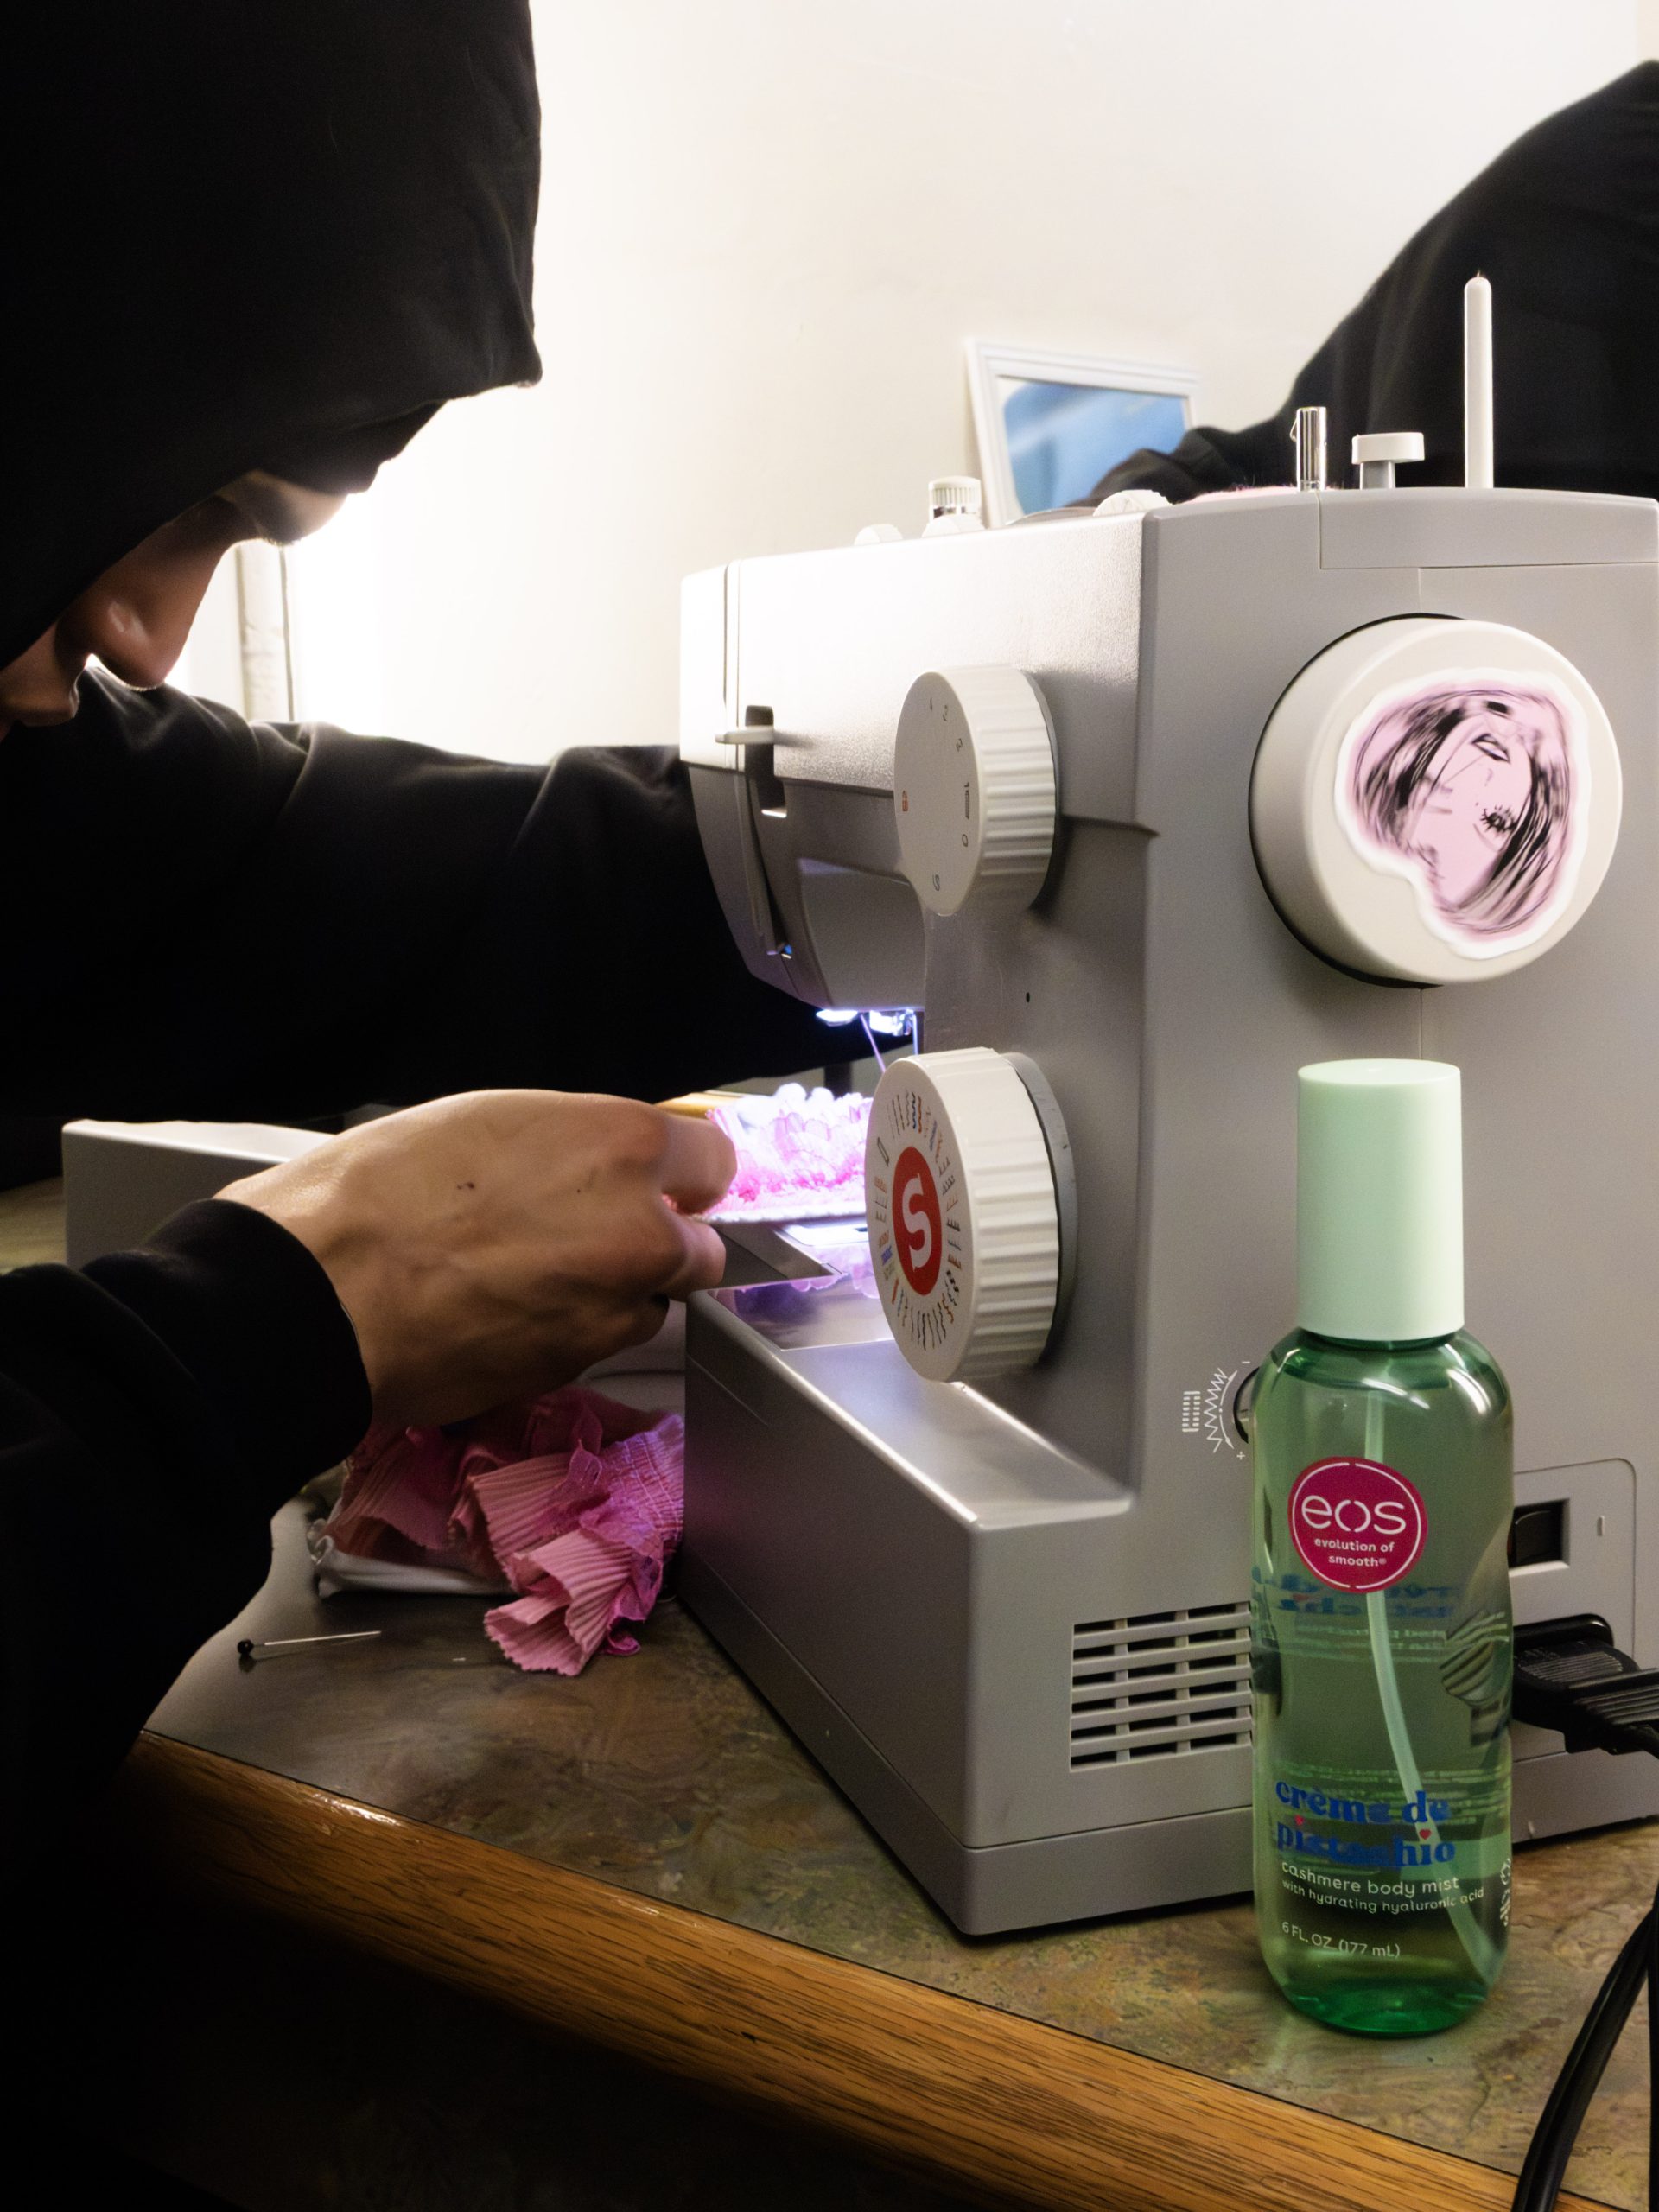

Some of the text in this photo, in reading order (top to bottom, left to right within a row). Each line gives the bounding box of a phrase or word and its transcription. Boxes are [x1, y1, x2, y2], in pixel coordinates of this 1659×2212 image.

[901, 1173, 932, 1274] S
[1301, 1495, 1407, 1535] eos
[1314, 1539, 1395, 1553] evolution of
[1402, 1790, 1452, 1824] de
[1277, 1816, 1456, 1868] pithio
[1281, 1861, 1459, 1898] cashmere body mist
[1282, 1879, 1484, 1916] with hydrating hyaluronic acid
[1281, 1922, 1289, 1934] 6
[1291, 1925, 1309, 1942] FL.
[1371, 1943, 1401, 1958] mL)
